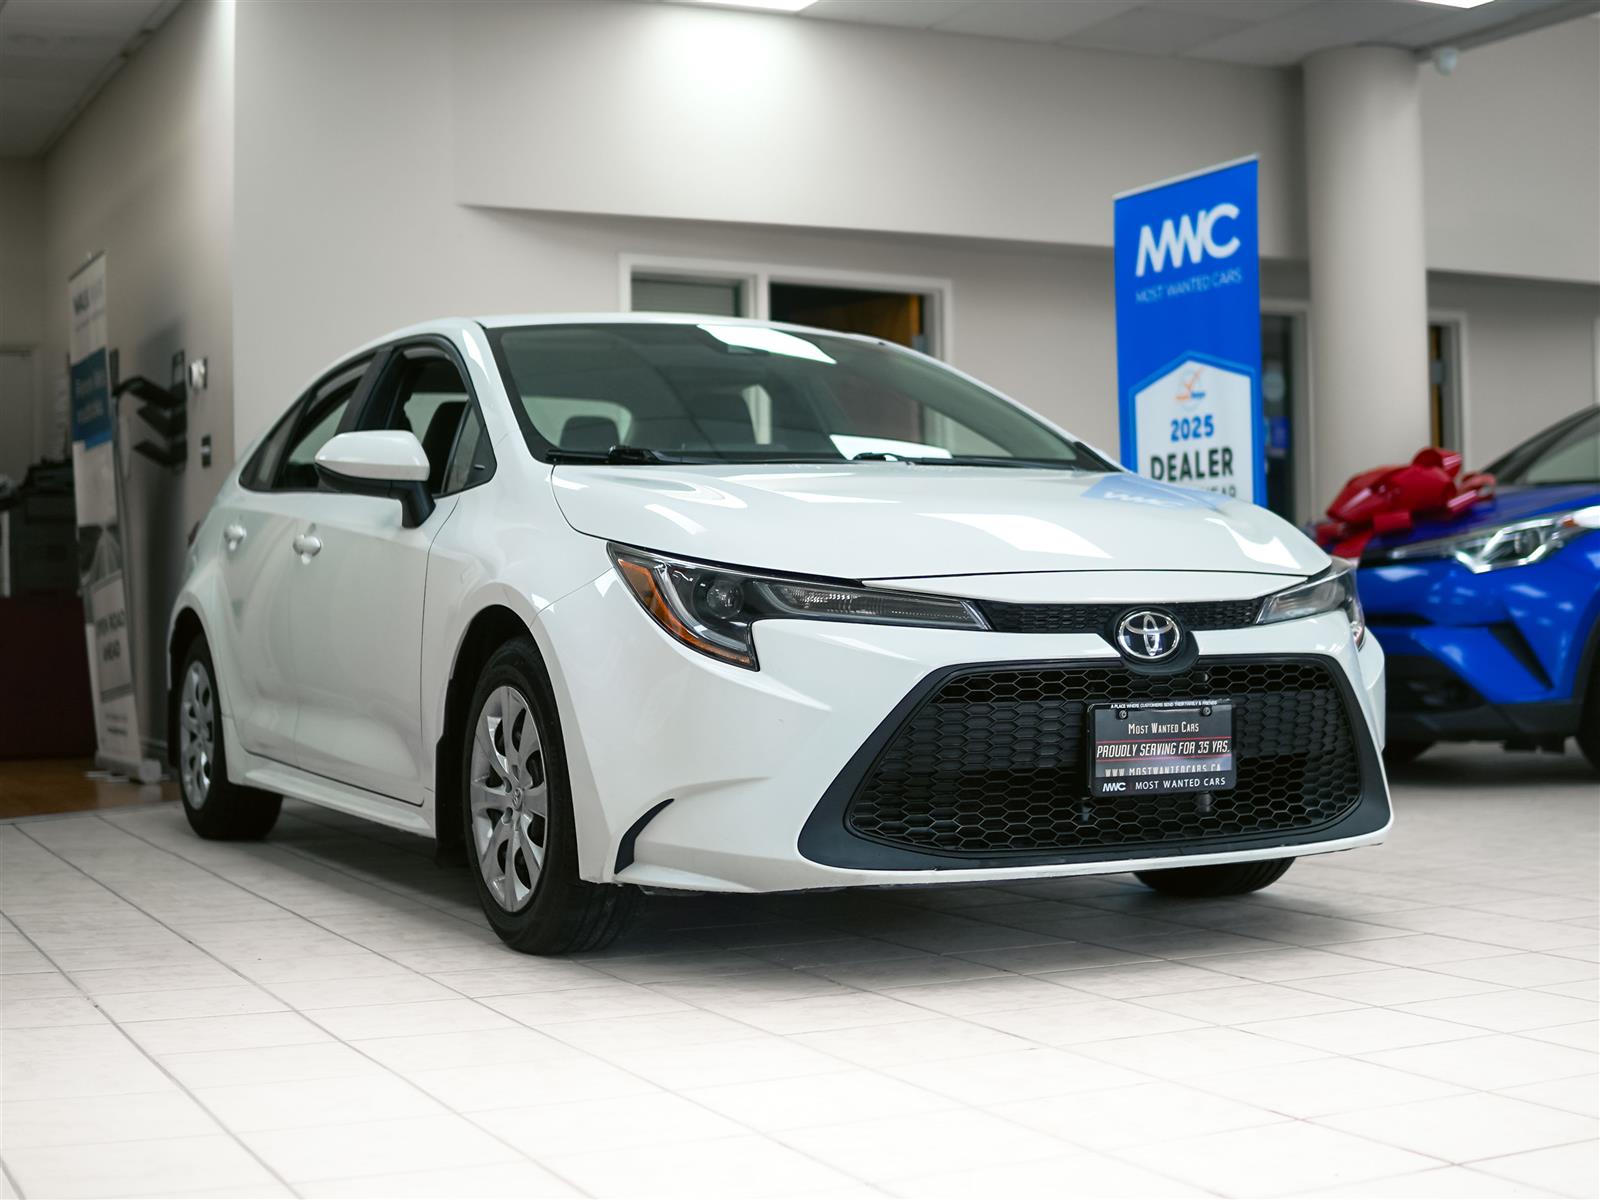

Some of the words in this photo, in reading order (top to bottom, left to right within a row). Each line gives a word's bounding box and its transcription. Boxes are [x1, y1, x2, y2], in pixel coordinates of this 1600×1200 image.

[1135, 202, 1241, 278] MWC
[1136, 285, 1162, 303] MOST
[1167, 275, 1210, 296] WANTED
[1212, 267, 1242, 287] CARS
[1170, 414, 1215, 442] 2025
[1150, 447, 1234, 482] DEALER
[1096, 744, 1138, 758] PROUDLY
[1139, 742, 1177, 757] SERVING
[1178, 741, 1195, 755] FOR
[1197, 740, 1209, 754] 35
[1211, 740, 1231, 753] YRS.
[1102, 782, 1126, 792] MWC
[1135, 780, 1159, 790] MOST
[1162, 778, 1200, 788] WANTED
[1203, 777, 1226, 786] CARS
